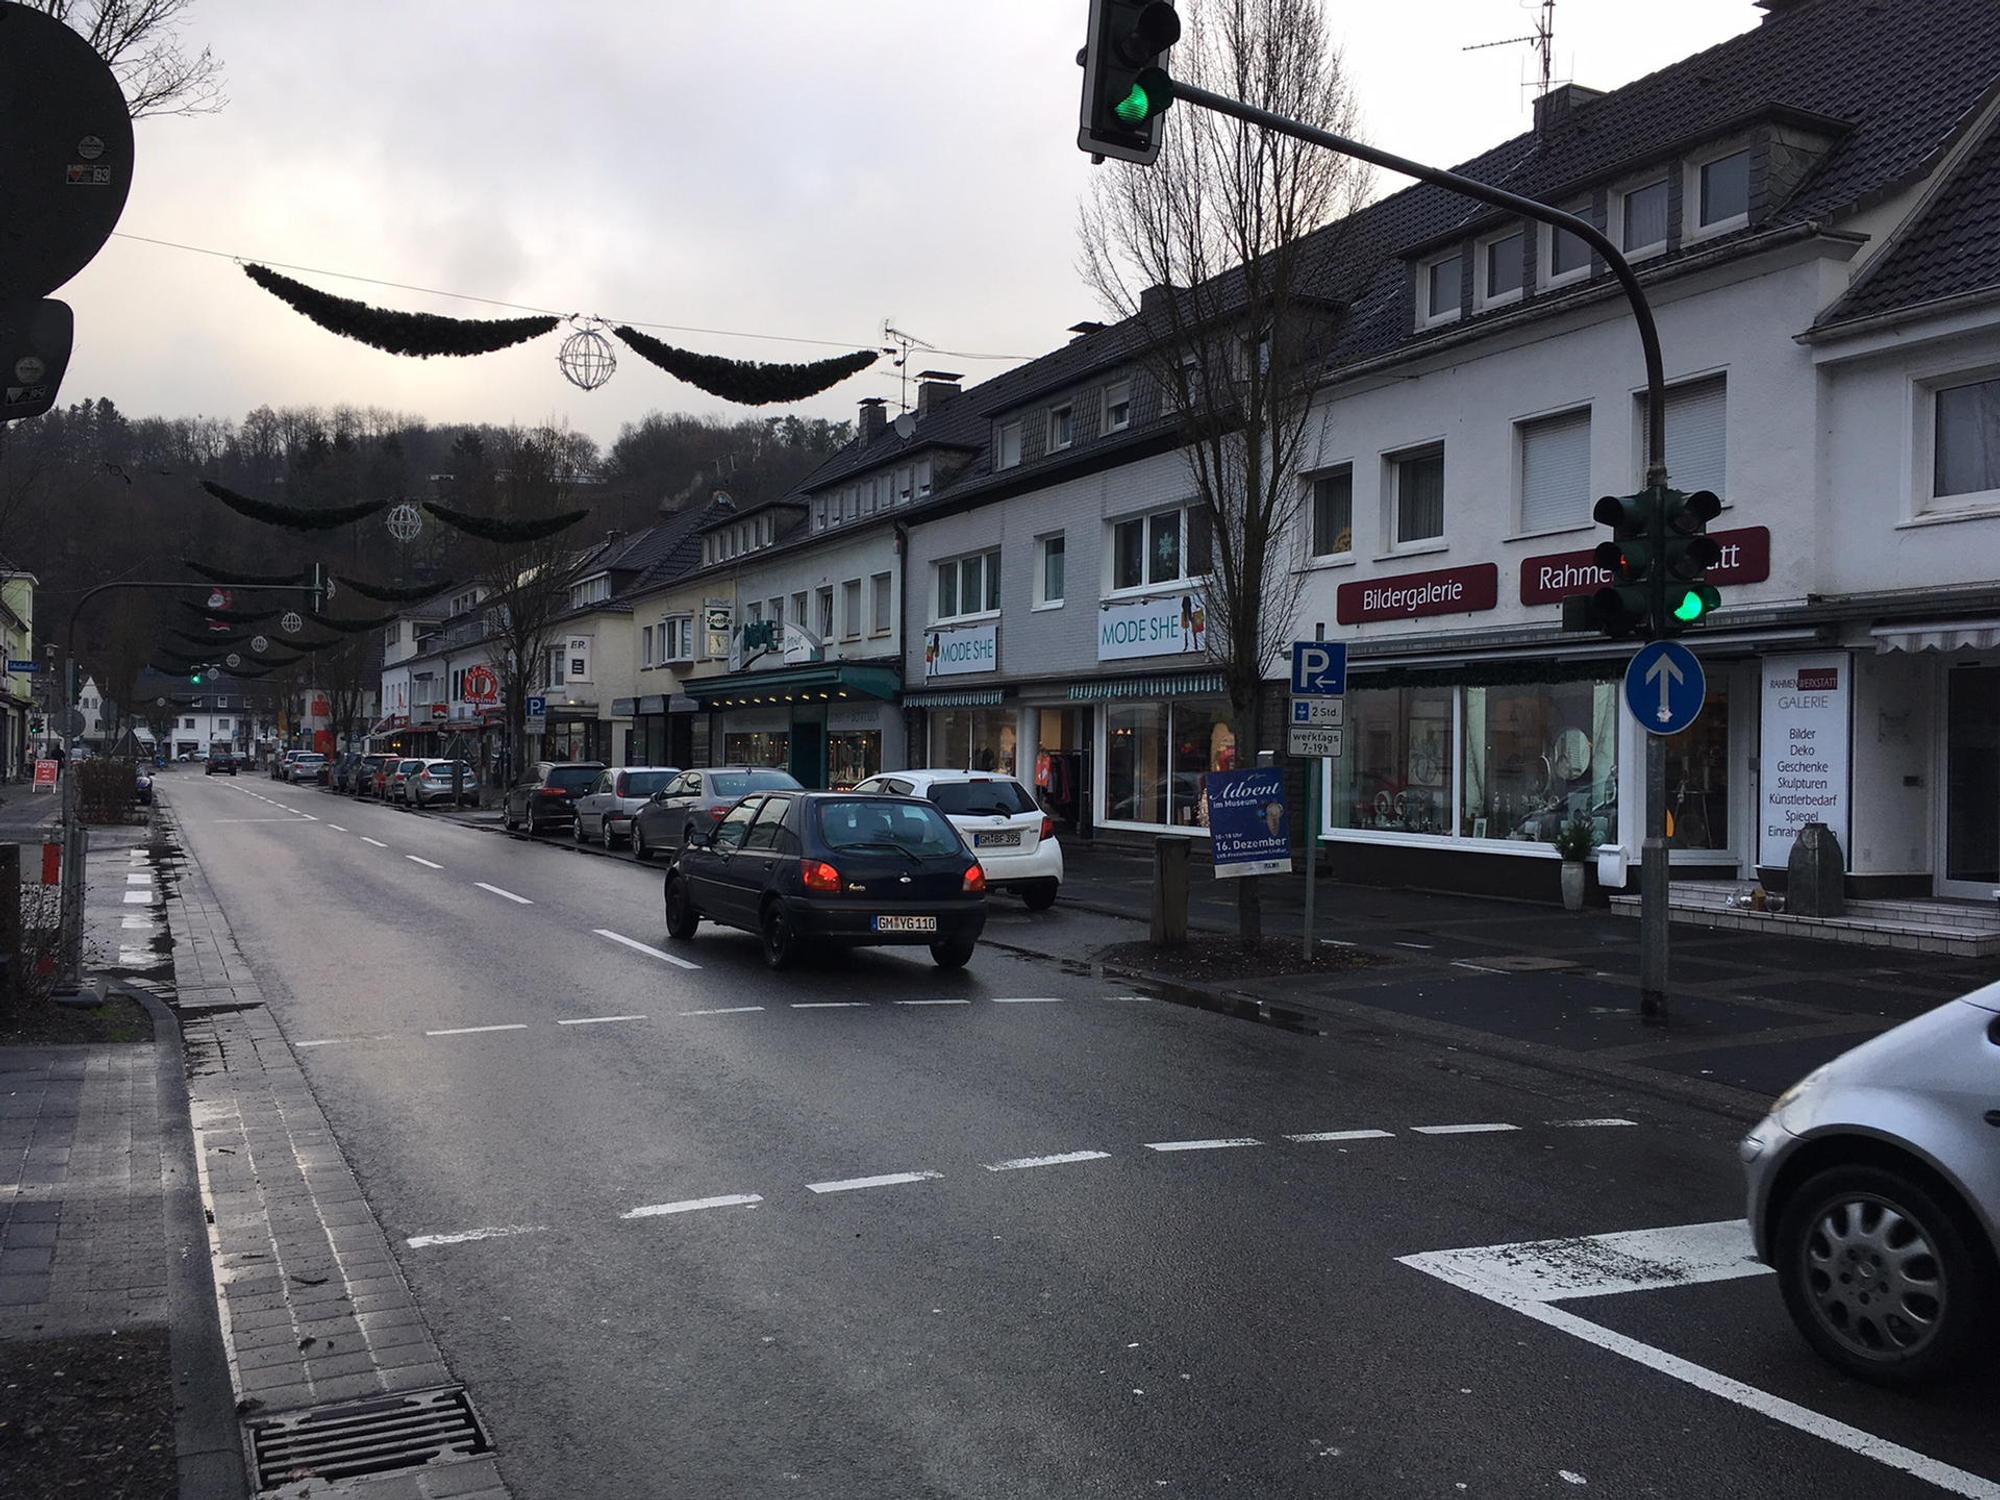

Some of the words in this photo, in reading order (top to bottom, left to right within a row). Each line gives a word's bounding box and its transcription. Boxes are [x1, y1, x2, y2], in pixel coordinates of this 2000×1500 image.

[1363, 579, 1463, 611] Bildergalerie
[1102, 622, 1146, 645] MODE
[1150, 615, 1179, 640] SHE
[941, 643, 972, 663] MODE
[973, 639, 993, 659] SHE
[1301, 648, 1330, 688] P
[530, 699, 541, 715] P
[1778, 695, 1829, 709] GALERIE
[1312, 707, 1318, 717] 2
[1292, 732, 1339, 744] werktags
[1789, 728, 1816, 740] Bilder
[1790, 744, 1815, 756] Deko
[1777, 761, 1829, 772] Geschenke
[1207, 781, 1280, 800] Advent
[1777, 777, 1827, 791] Skulpturen
[1213, 800, 1223, 808] im
[1224, 799, 1257, 808] Museum
[1769, 793, 1837, 806] Künstlerbedarf
[1785, 809, 1819, 823] Spiegel
[1216, 841, 1231, 852] 16.
[1233, 837, 1287, 850] Dezember
[880, 917, 893, 929] GM
[916, 918, 935, 929] 110
